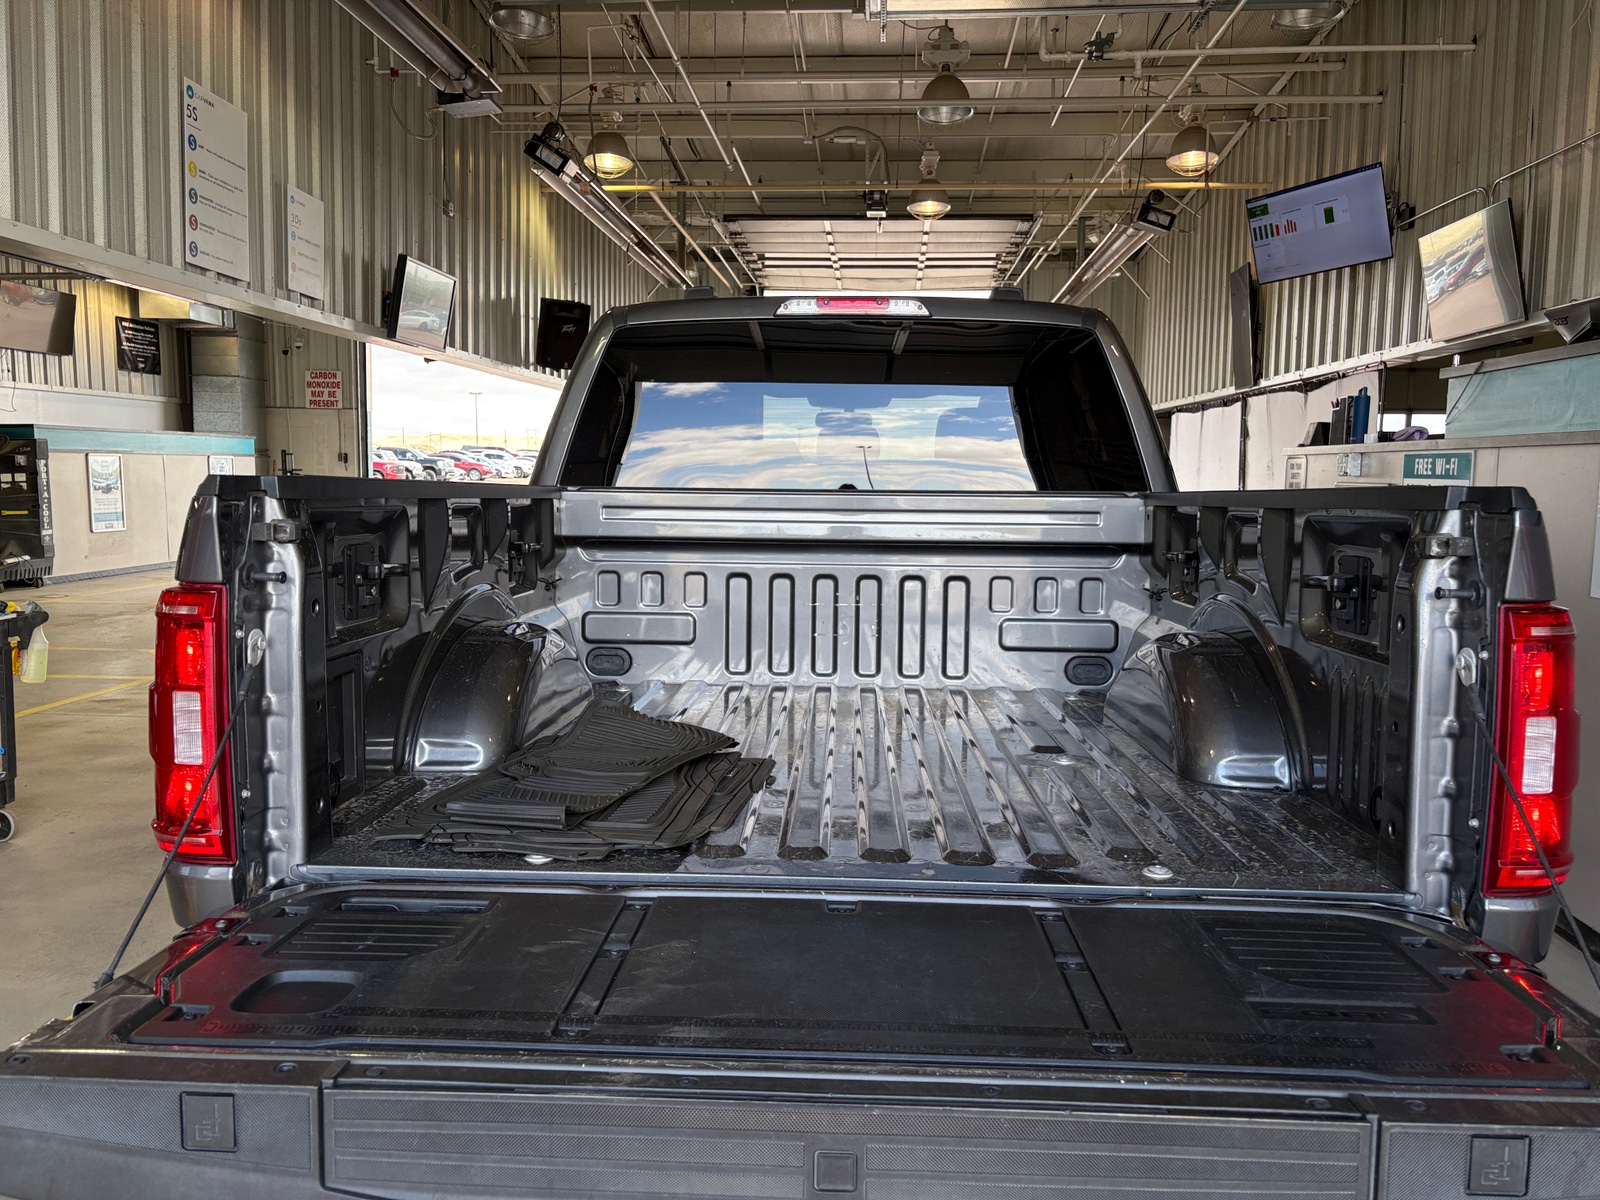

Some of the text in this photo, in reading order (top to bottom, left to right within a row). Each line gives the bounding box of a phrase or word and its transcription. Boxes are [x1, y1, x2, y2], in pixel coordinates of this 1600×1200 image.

[186, 103, 198, 122] 5S
[1553, 316, 1570, 325] acer
[310, 371, 337, 380] CARBON
[306, 381, 341, 389] MONOXIDE
[311, 390, 337, 398] MAY BE
[309, 399, 339, 407] PRESENT
[1414, 457, 1458, 476] FREE WI-FI
